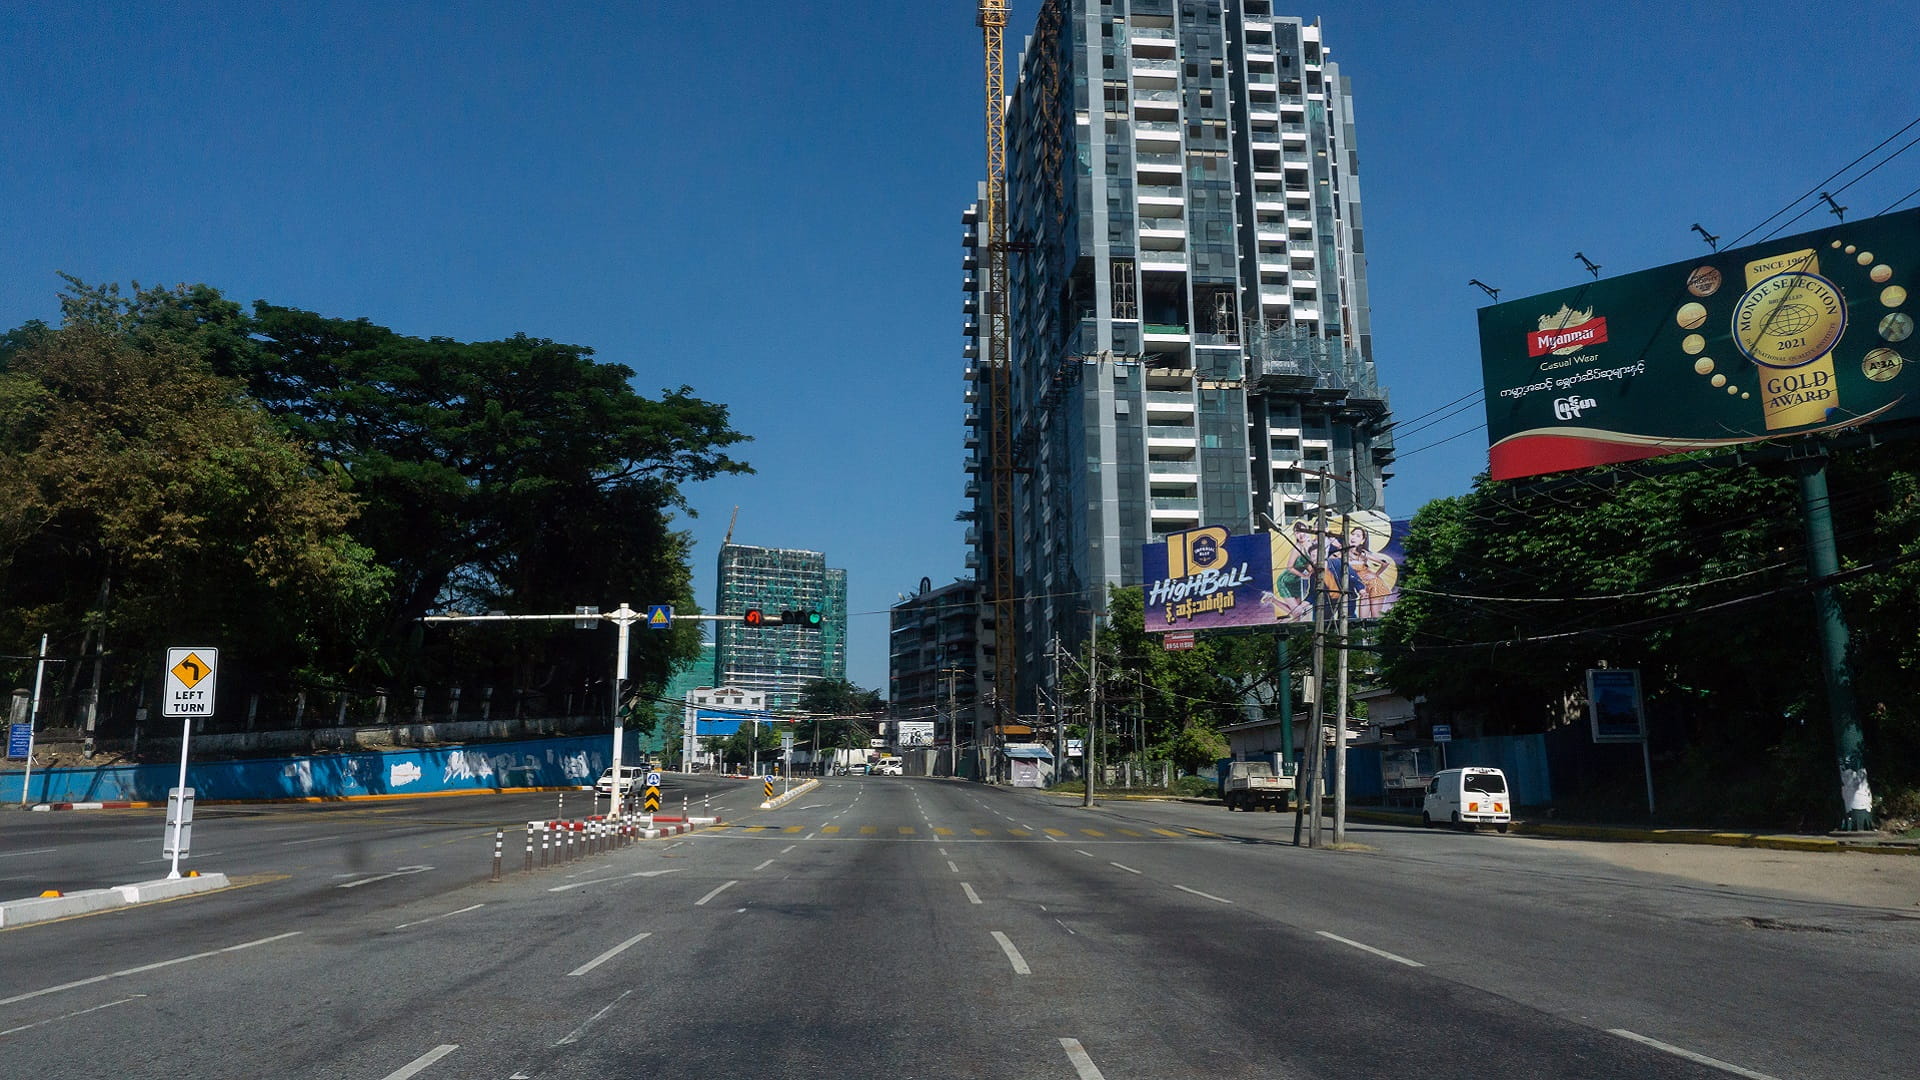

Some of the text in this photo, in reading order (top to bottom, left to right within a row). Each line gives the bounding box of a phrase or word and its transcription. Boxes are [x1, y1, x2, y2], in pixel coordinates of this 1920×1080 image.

[1753, 260, 1785, 273] SINCE
[1741, 278, 1837, 331] MONDE SELECTION
[1537, 328, 1595, 349] Myanmar
[1777, 337, 1807, 351] 2021
[1540, 354, 1599, 371] Casual Wear
[1767, 371, 1829, 394] GOLD
[1769, 388, 1831, 409] AWARD
[175, 691, 204, 699] LEFT
[174, 704, 205, 712] TURN
